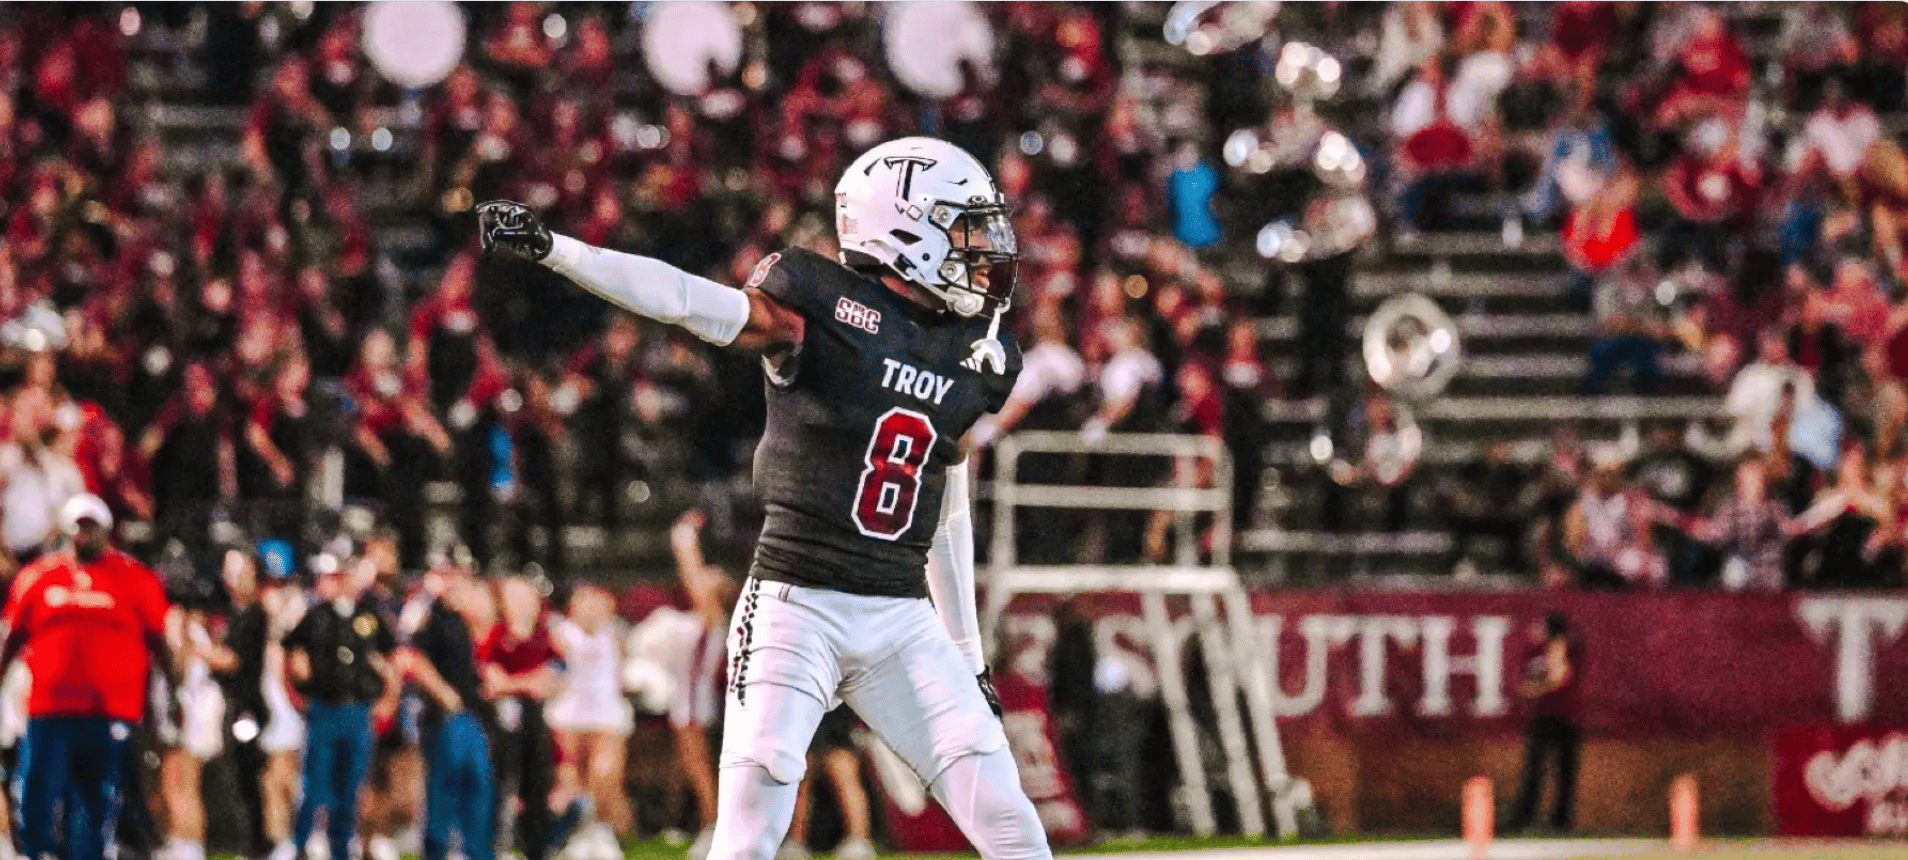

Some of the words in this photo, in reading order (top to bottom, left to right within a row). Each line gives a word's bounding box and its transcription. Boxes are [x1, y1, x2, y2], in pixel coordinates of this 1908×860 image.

[834, 296, 882, 334] SBC
[881, 357, 955, 406] TROY
[851, 406, 938, 541] 8
